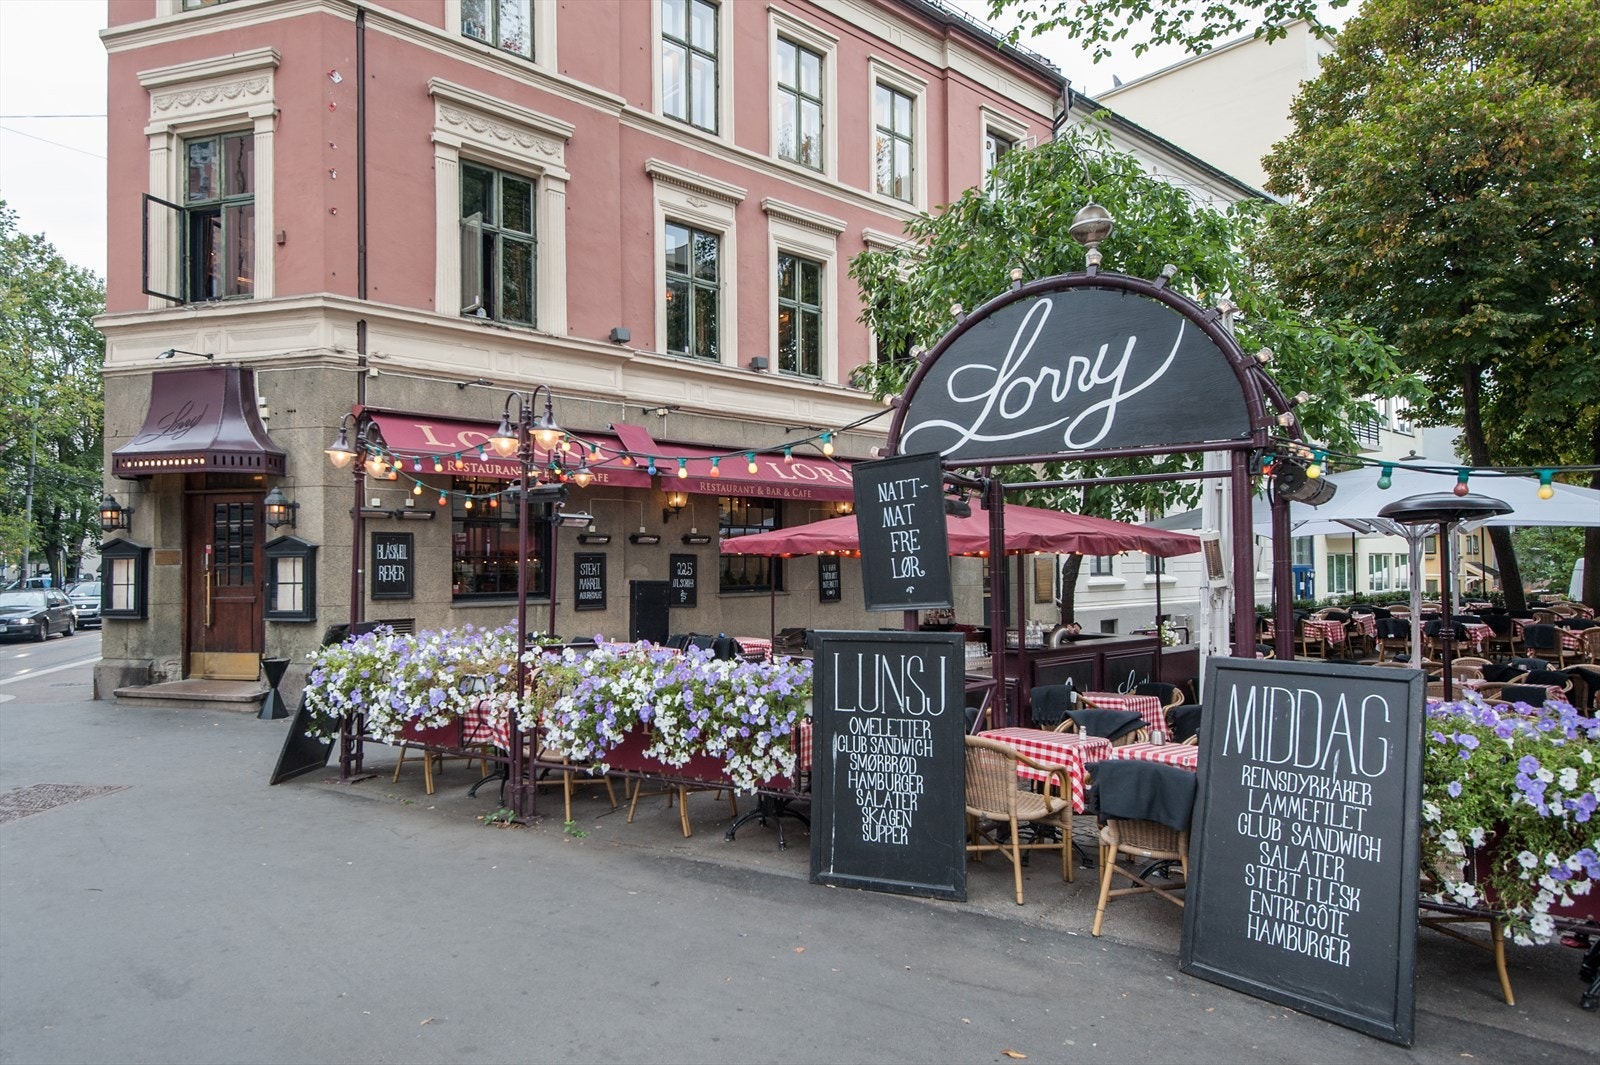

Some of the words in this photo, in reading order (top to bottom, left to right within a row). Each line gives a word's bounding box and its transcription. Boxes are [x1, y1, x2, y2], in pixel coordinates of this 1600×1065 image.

[900, 298, 1186, 457] Lorry
[134, 400, 208, 445] Lorry
[700, 481, 754, 494] RESTAURANT
[757, 486, 764, 495] &
[766, 487, 782, 497] BAR
[784, 488, 791, 497] &
[882, 503, 916, 528] MAT
[890, 529, 921, 554] FRE
[378, 564, 405, 583] REKER
[676, 562, 693, 576] 225
[833, 652, 947, 716] LUNSJ
[849, 716, 932, 739] OMELETTER
[1222, 683, 1391, 778] MIDDAG
[837, 735, 867, 753] CLUB
[870, 736, 933, 757] SANDWICH
[850, 753, 917, 774] SMØRBRØD
[848, 770, 924, 794] HAMBURGER
[1241, 764, 1373, 806] REINSDYRKAKER
[856, 788, 918, 811] SALATER
[1248, 788, 1368, 832] LAMMEFILET
[861, 807, 912, 827] SKAGEN
[862, 824, 909, 845] SUPPER
[1237, 812, 1282, 842] CLUB
[1291, 822, 1382, 862] SANDWICH
[1259, 841, 1345, 882] SALATER
[1244, 863, 1301, 897] STEKT
[1306, 877, 1361, 912] FLESK
[1249, 889, 1350, 938] ENTRECÔTE
[1247, 913, 1351, 967] HAMBURGER
